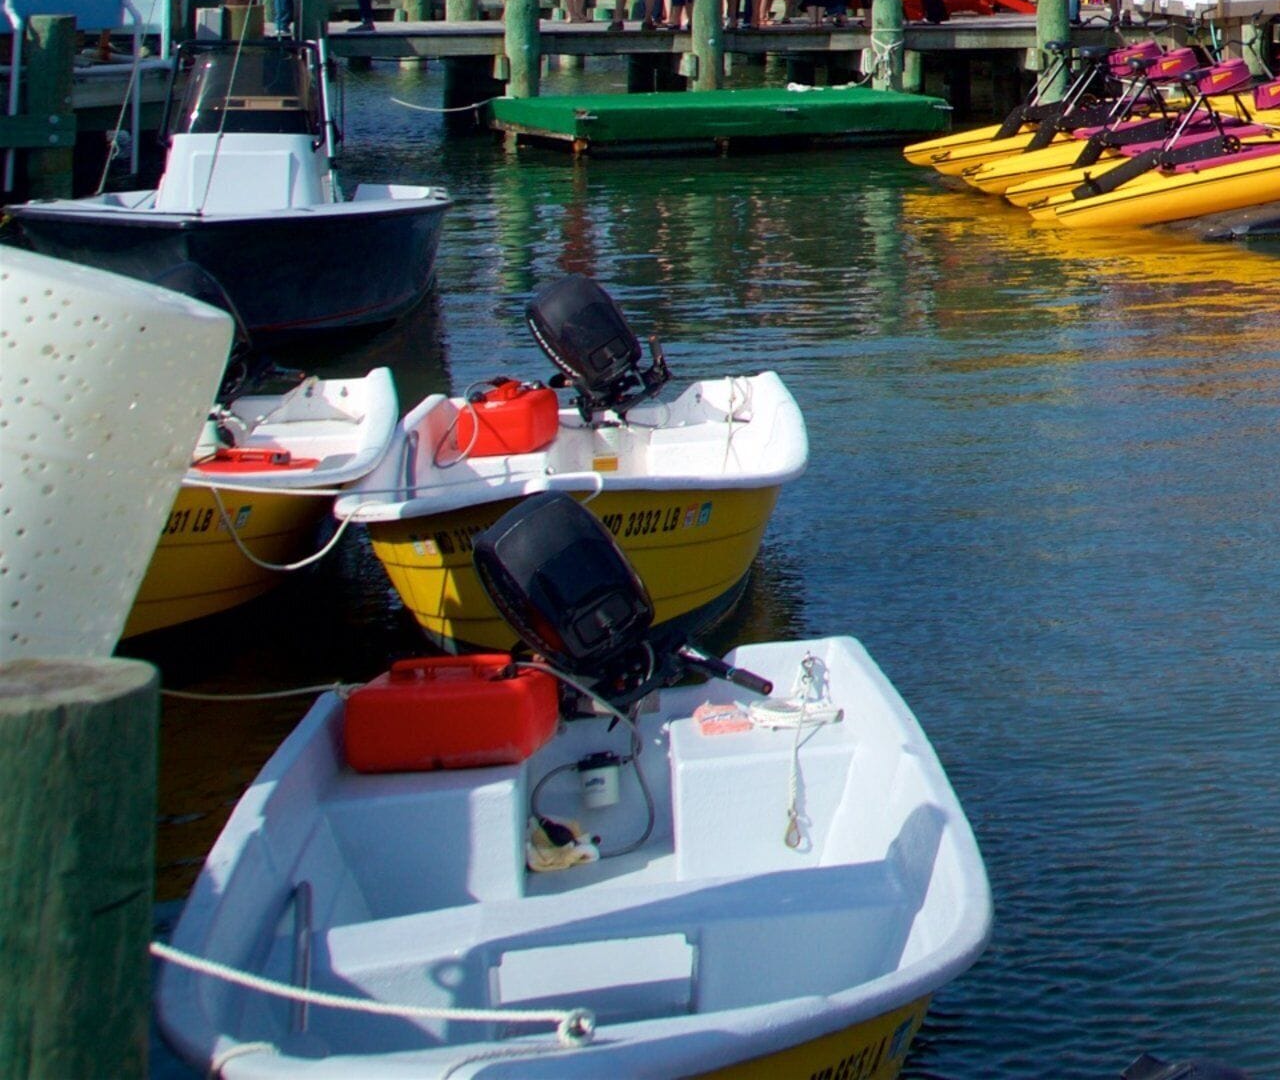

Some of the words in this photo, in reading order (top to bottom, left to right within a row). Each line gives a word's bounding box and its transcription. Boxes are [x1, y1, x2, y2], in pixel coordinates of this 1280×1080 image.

[192, 508, 214, 532] LB
[624, 508, 661, 538] 3332
[662, 506, 681, 532] LB
